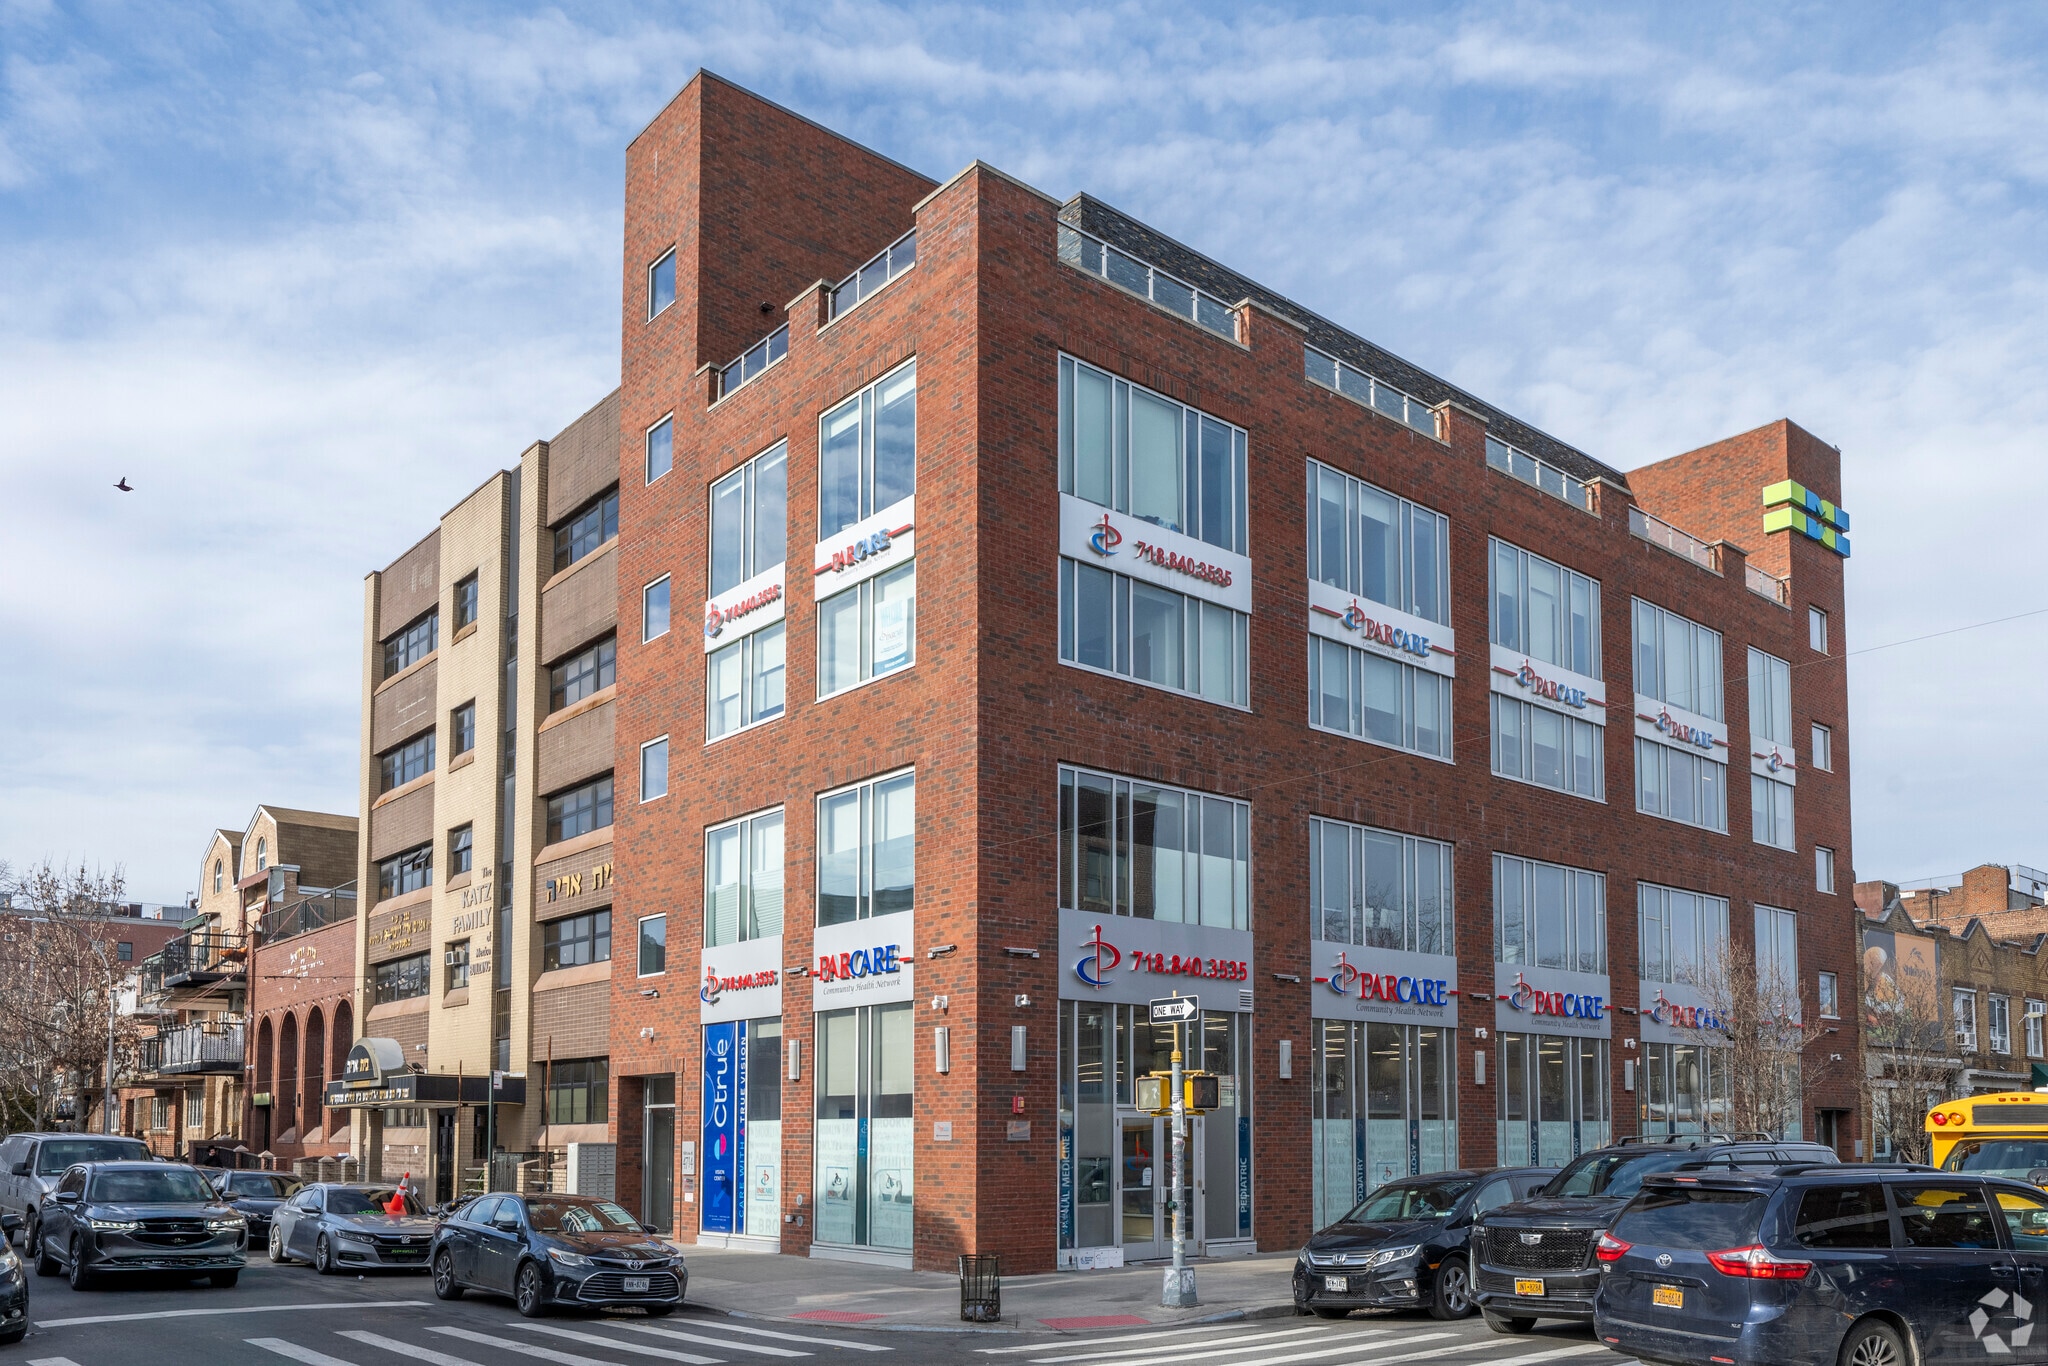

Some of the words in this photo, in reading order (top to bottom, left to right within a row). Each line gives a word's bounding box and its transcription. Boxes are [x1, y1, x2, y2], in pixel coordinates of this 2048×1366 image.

[832, 528, 891, 572] PARCARE
[1136, 540, 1232, 587] 718.840.3535
[724, 584, 781, 622] 718.840.3535
[1365, 618, 1430, 657] PARCARE
[1535, 676, 1586, 709] PARCARE
[1671, 721, 1713, 750] PARCARE
[483, 867, 492, 878] The
[463, 882, 492, 908] KATZ
[453, 906, 492, 935] FAMILY
[819, 944, 898, 982] PARCARE
[1132, 950, 1247, 981] 718.840.3535
[721, 970, 777, 991] 718.840.3535
[823, 984, 855, 996] Community
[855, 980, 874, 992] Health
[875, 978, 901, 988] Network
[1360, 972, 1448, 1007] PARCARE
[1154, 1006, 1166, 1016] ONE
[1170, 1005, 1184, 1014] WAY
[1355, 1003, 1393, 1017] Community
[1394, 1005, 1416, 1016] Health
[1417, 1008, 1444, 1018] Network
[1534, 990, 1604, 1020] PARCARE
[714, 1039, 728, 1128] Ctrue
[1062, 1135, 1071, 1187] MEDICINE
